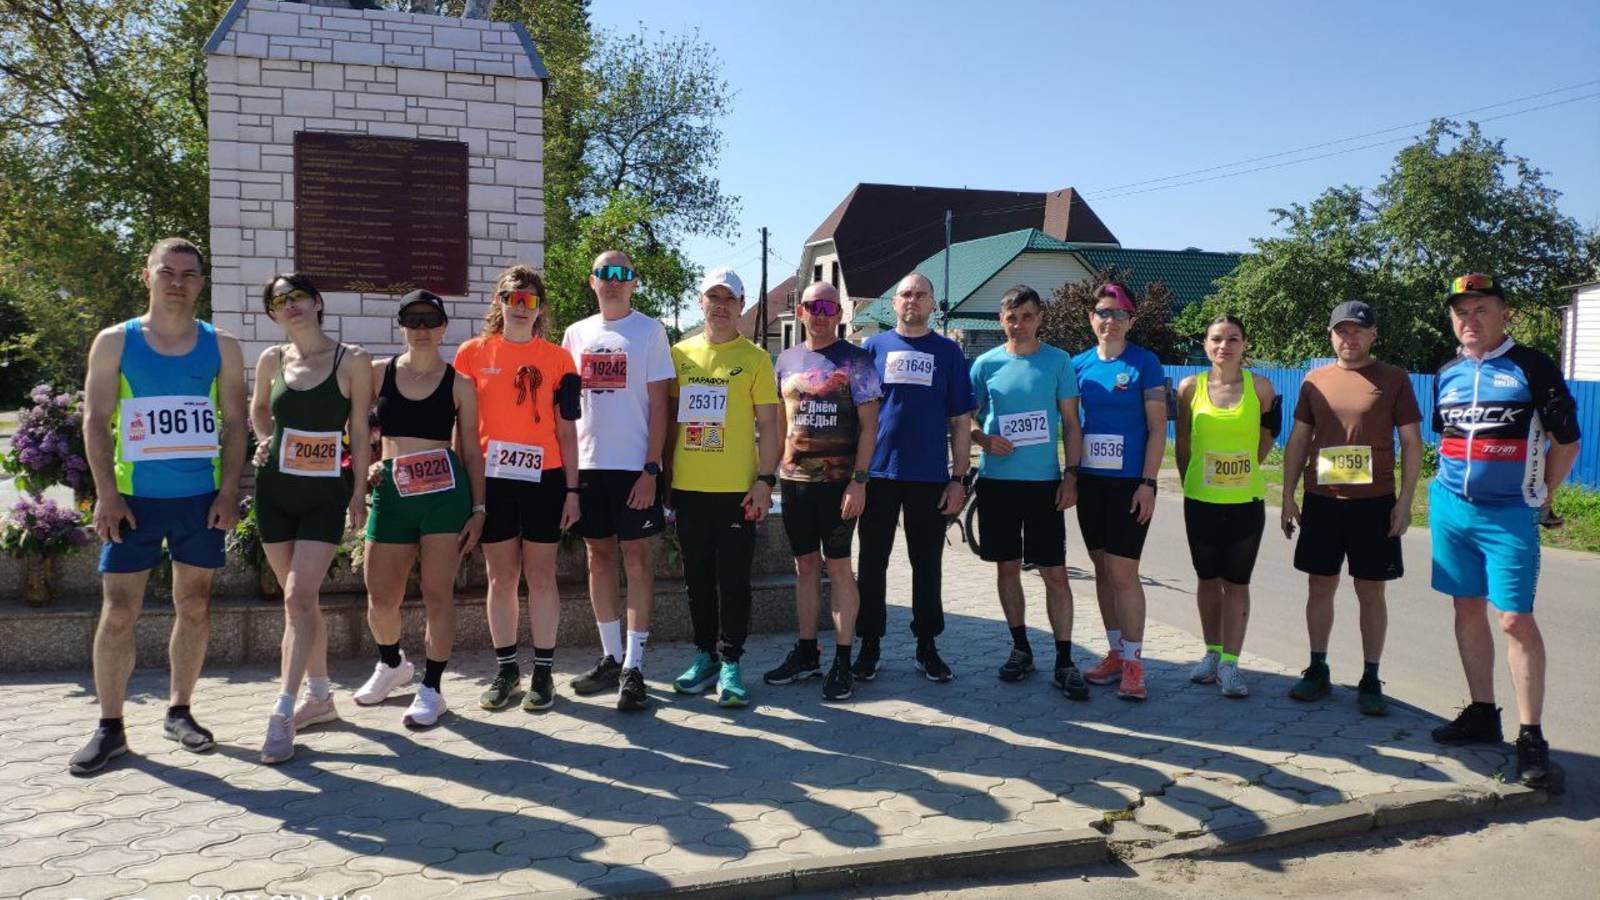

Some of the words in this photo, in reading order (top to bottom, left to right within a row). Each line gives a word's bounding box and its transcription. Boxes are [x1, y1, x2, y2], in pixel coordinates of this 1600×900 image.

[592, 361, 627, 376] 19242
[897, 359, 932, 374] 21649
[689, 394, 726, 410] 25317
[800, 400, 806, 412] С
[808, 400, 837, 414] Днём
[146, 409, 215, 435] 19616
[1440, 406, 1524, 423] TRACK
[1010, 417, 1046, 433] 23972
[296, 442, 336, 458] 20426
[1090, 442, 1124, 458] 19536
[1482, 445, 1518, 454] TEAM
[500, 450, 542, 470] 24733
[1216, 460, 1251, 475] 20078
[406, 458, 450, 479] 19220
